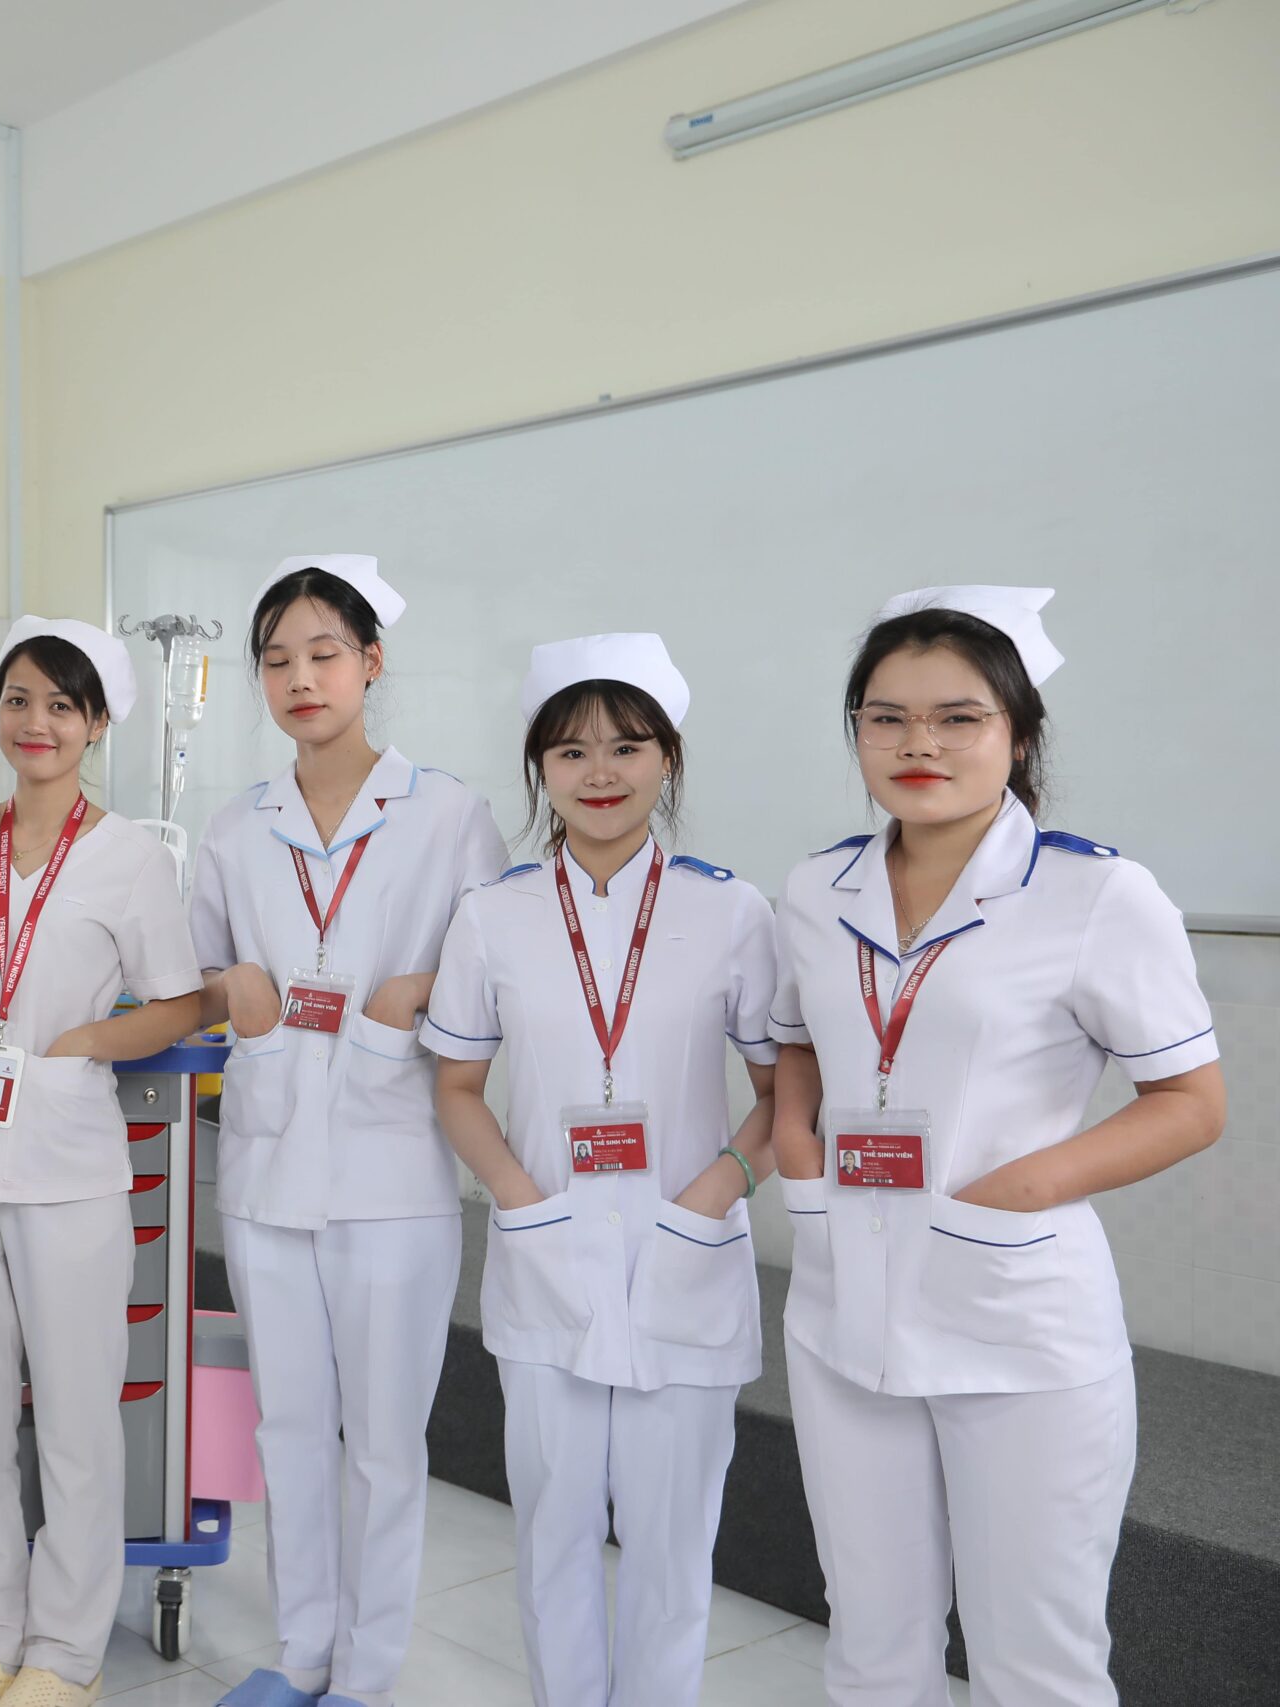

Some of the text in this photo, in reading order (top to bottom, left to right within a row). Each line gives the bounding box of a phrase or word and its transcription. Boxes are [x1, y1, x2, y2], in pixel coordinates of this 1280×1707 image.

[0, 830, 9, 895] YERSIN UNIVERSITY
[36, 837, 70, 900] YERSIN UNIVERSITY
[560, 883, 579, 934] YERSIN UNIVERSITY
[638, 880, 657, 929] YERSIN UNIVERSITY
[5, 920, 33, 993] YERSIN UNIVERSITY
[576, 950, 598, 1008] YERSIN UNIVERSITY
[621, 946, 641, 1004] YERSIN UNIVERSITY
[862, 972, 873, 999] YERSIN
[902, 974, 918, 1000] YERSIN
[621, 1137, 637, 1145] VIÊN
[862, 1150, 876, 1158] THẺ
[895, 1151, 913, 1159] VIÊN
